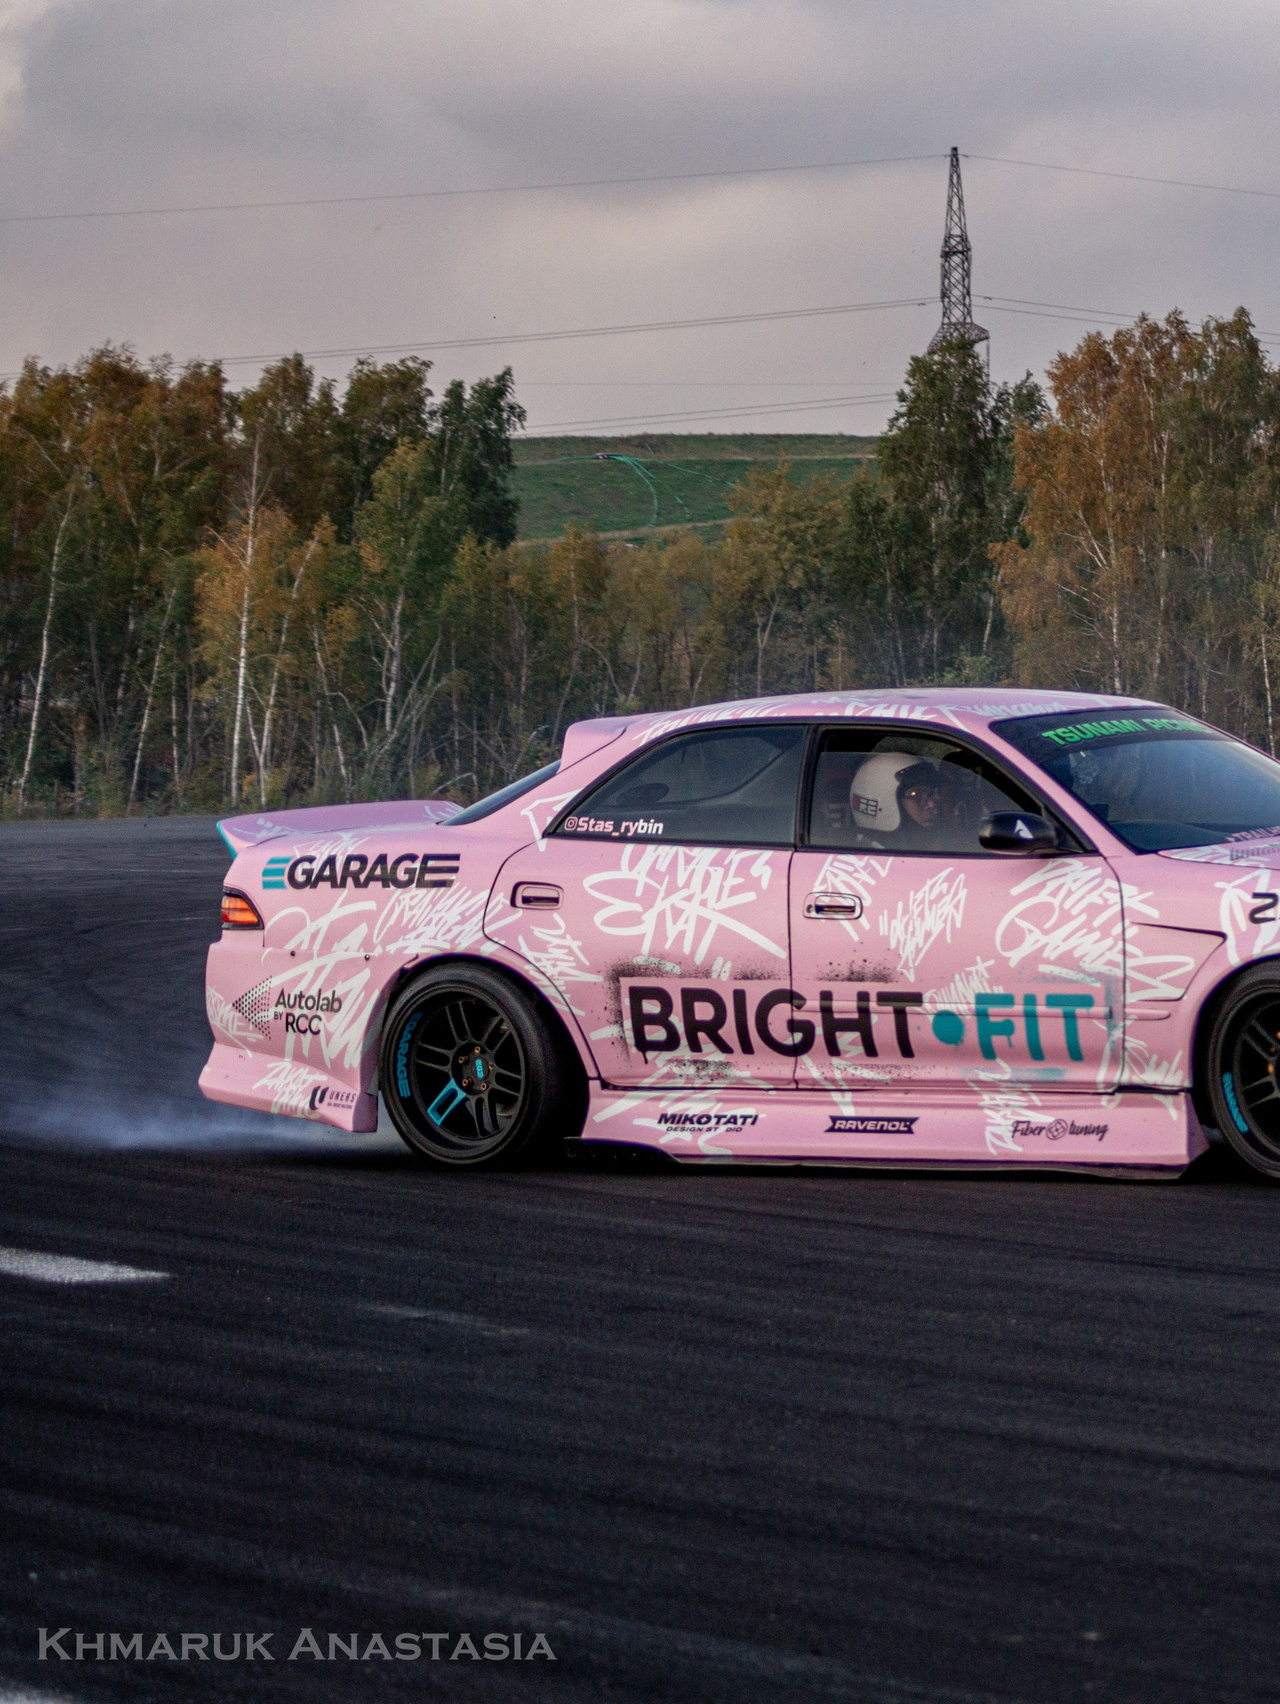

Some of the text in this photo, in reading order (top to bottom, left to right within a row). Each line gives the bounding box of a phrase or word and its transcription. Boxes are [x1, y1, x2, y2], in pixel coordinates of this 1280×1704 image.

[1041, 719, 1147, 746] TSUNAMI
[577, 817, 664, 837] Stas_rybin
[275, 988, 342, 1013] Autolab
[274, 1011, 322, 1035] BY RCC
[628, 985, 924, 1063] BRIGHT
[975, 993, 1096, 1061] FIT
[657, 1113, 759, 1126] MIKOTATI
[834, 1120, 909, 1131] RAVENOL
[1011, 1120, 1109, 1141] Fiber tuning
